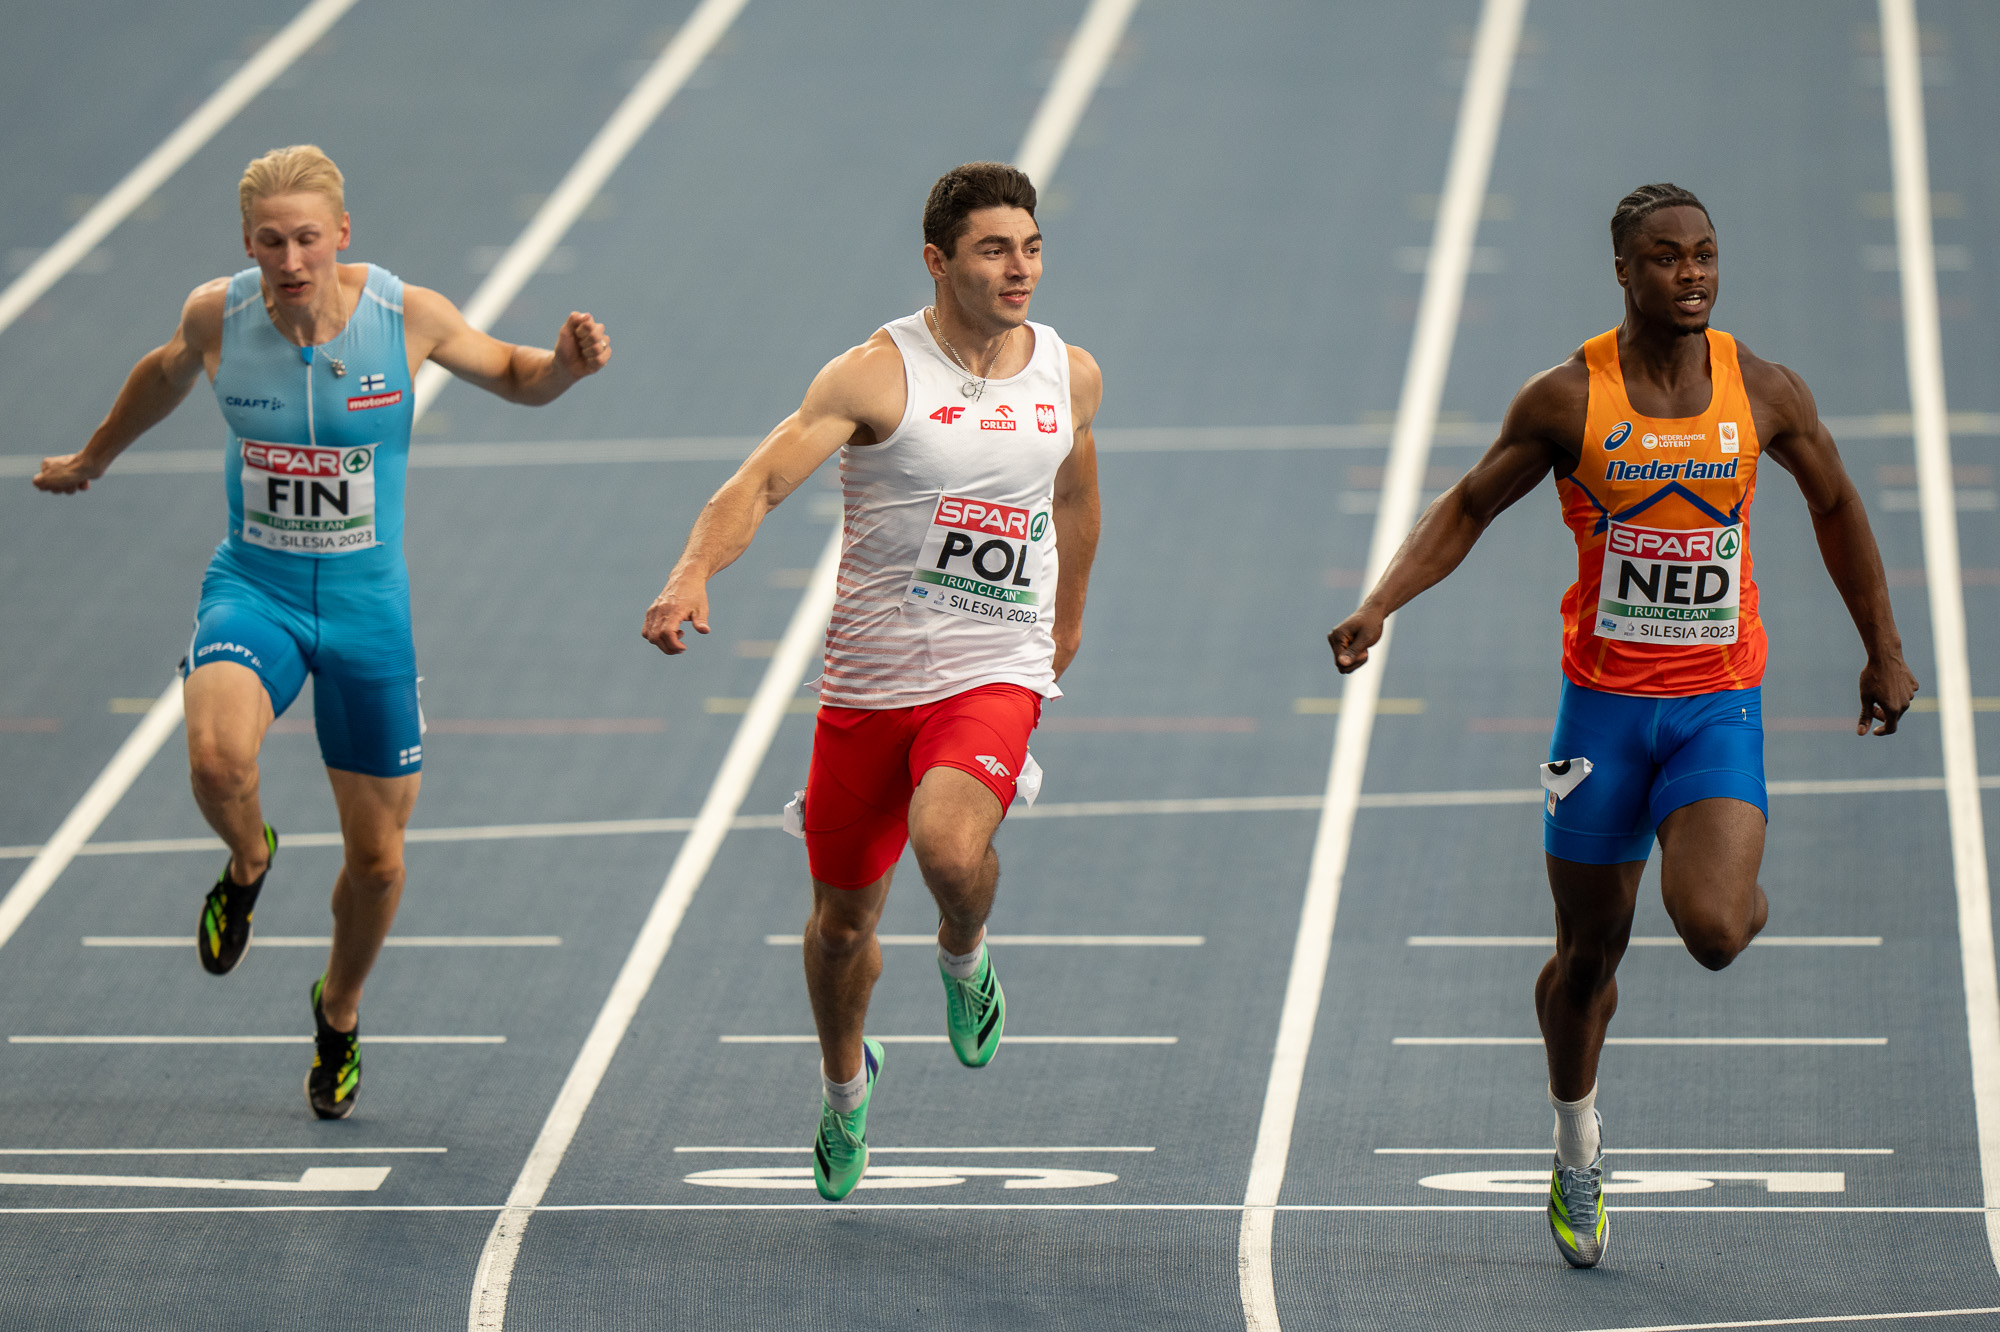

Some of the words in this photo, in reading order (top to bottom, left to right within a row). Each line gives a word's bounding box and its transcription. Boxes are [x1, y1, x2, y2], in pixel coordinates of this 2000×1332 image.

[226, 396, 270, 409] CRAFT
[929, 406, 966, 424] 4F
[982, 421, 1015, 430] ORLEN
[1658, 433, 1706, 441] NEDERLANDSE
[1658, 440, 1691, 448] LOTERIJ
[245, 448, 339, 474] SPAR
[1604, 457, 1739, 481] Nederland
[268, 477, 349, 517] FIN
[938, 501, 1027, 535] SPAR
[280, 535, 335, 548] SILESIA
[339, 531, 373, 546] 2023
[1611, 530, 1710, 558] SPAR
[936, 531, 1031, 587] POL
[947, 576, 976, 592] RUN
[1618, 560, 1730, 605] NED
[949, 595, 1004, 619] SILESIA
[1007, 608, 1038, 624] 2023
[1634, 607, 1664, 618] RUN
[1640, 624, 1697, 639] SILESIA
[1700, 625, 1735, 638] 2023
[197, 642, 253, 658] CRAFT
[975, 754, 1011, 777] 4F
[683, 1166, 1119, 1189] 6
[1417, 1170, 1845, 1194] 5
